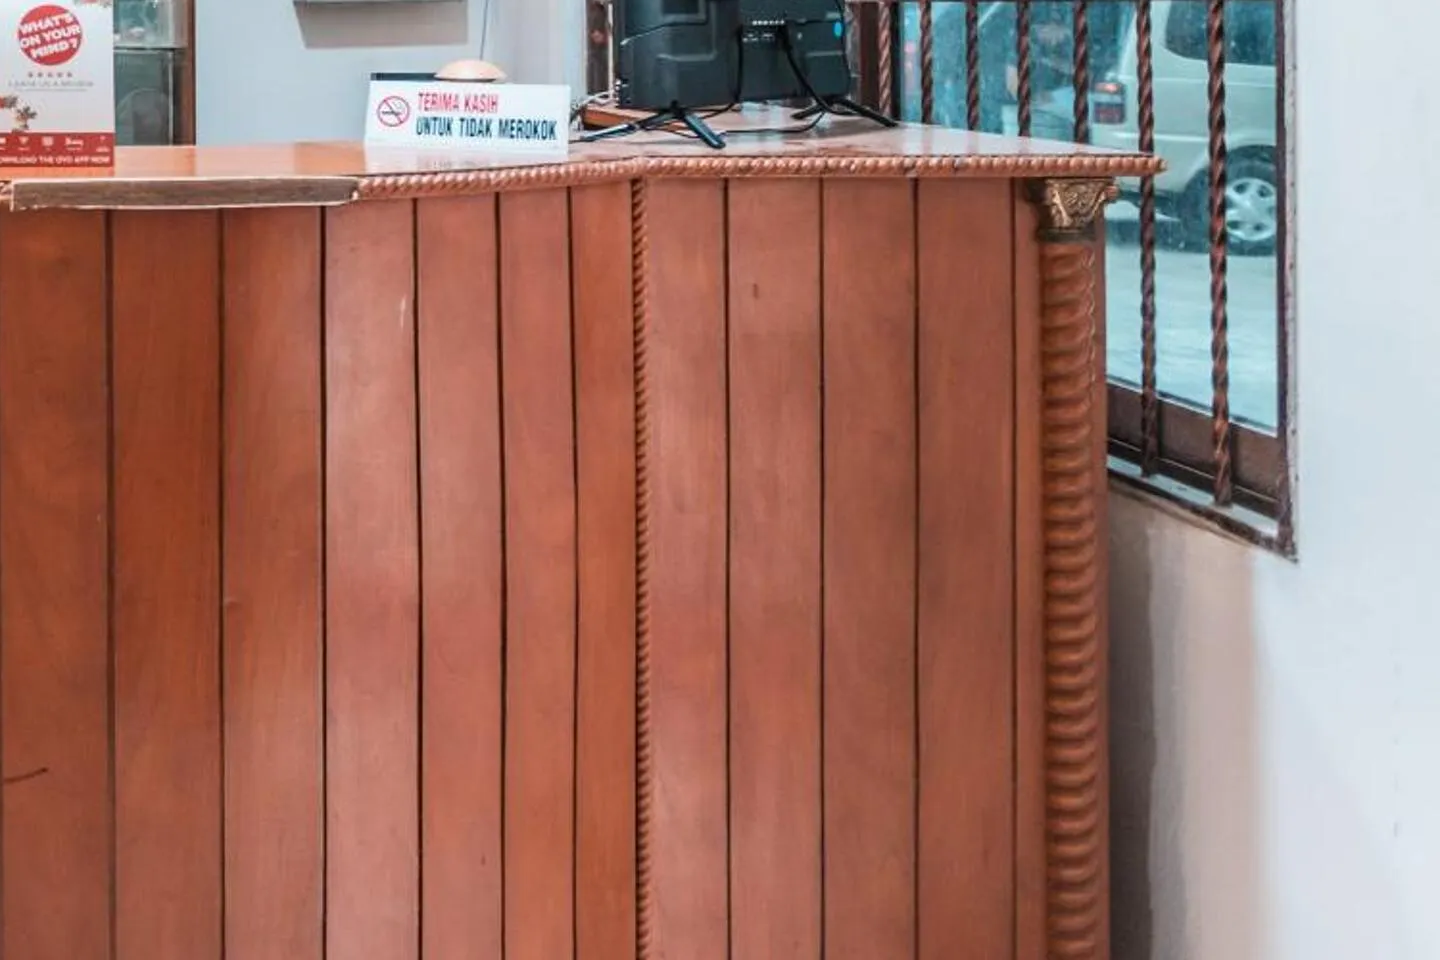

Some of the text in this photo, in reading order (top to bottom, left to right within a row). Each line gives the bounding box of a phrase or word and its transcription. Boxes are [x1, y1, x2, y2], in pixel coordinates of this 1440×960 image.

[20, 13, 74, 34] WHAT'S
[20, 24, 80, 49] ON YOUR
[418, 92, 499, 113] TERIMA KASIH
[416, 116, 557, 140] UNTUK TIDAK MEROKOK
